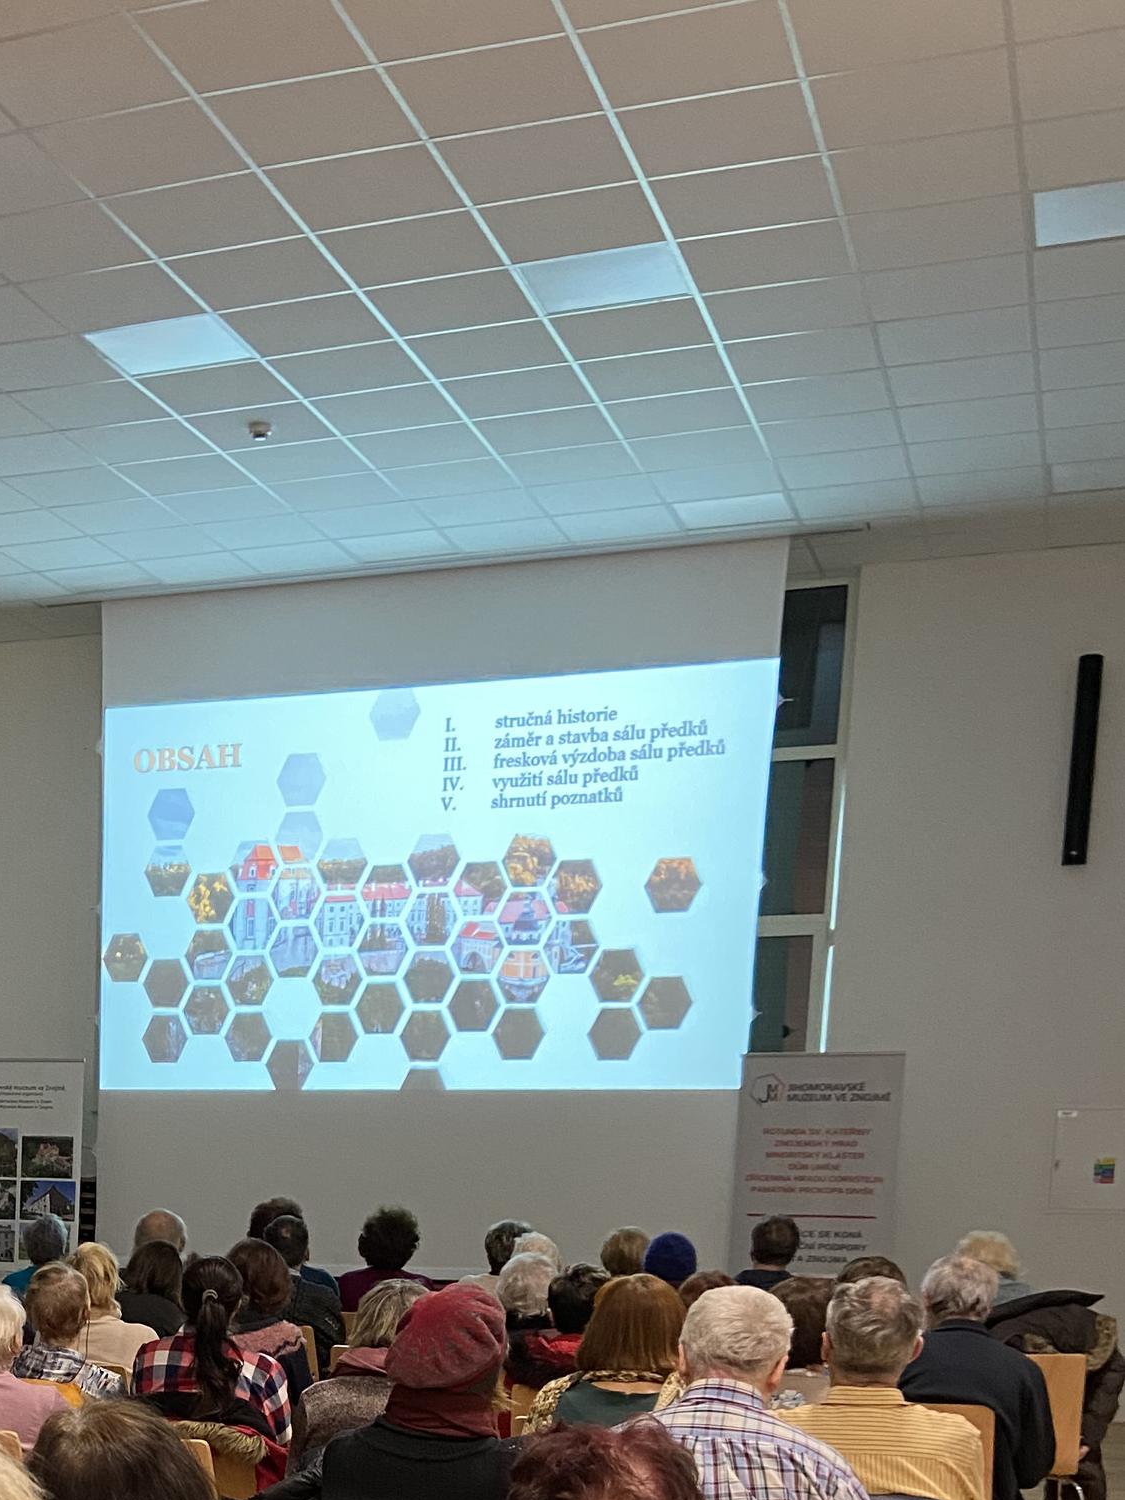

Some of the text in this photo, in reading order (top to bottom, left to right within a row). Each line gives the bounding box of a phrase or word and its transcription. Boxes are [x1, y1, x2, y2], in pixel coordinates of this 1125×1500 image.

[444, 706, 618, 732] I. stručná historie
[444, 719, 708, 752] II. záměr a stavba sálu předků
[133, 743, 243, 773] OBSAH
[443, 738, 726, 772] III. fresková výzdoba sálu předků
[442, 765, 639, 792] IV. využití sálu předků
[441, 786, 624, 811] V. shrnutí poznatků
[787, 1093, 832, 1102] MUZEUM
[834, 1093, 847, 1102] VE
[818, 1230, 832, 1238] SE
